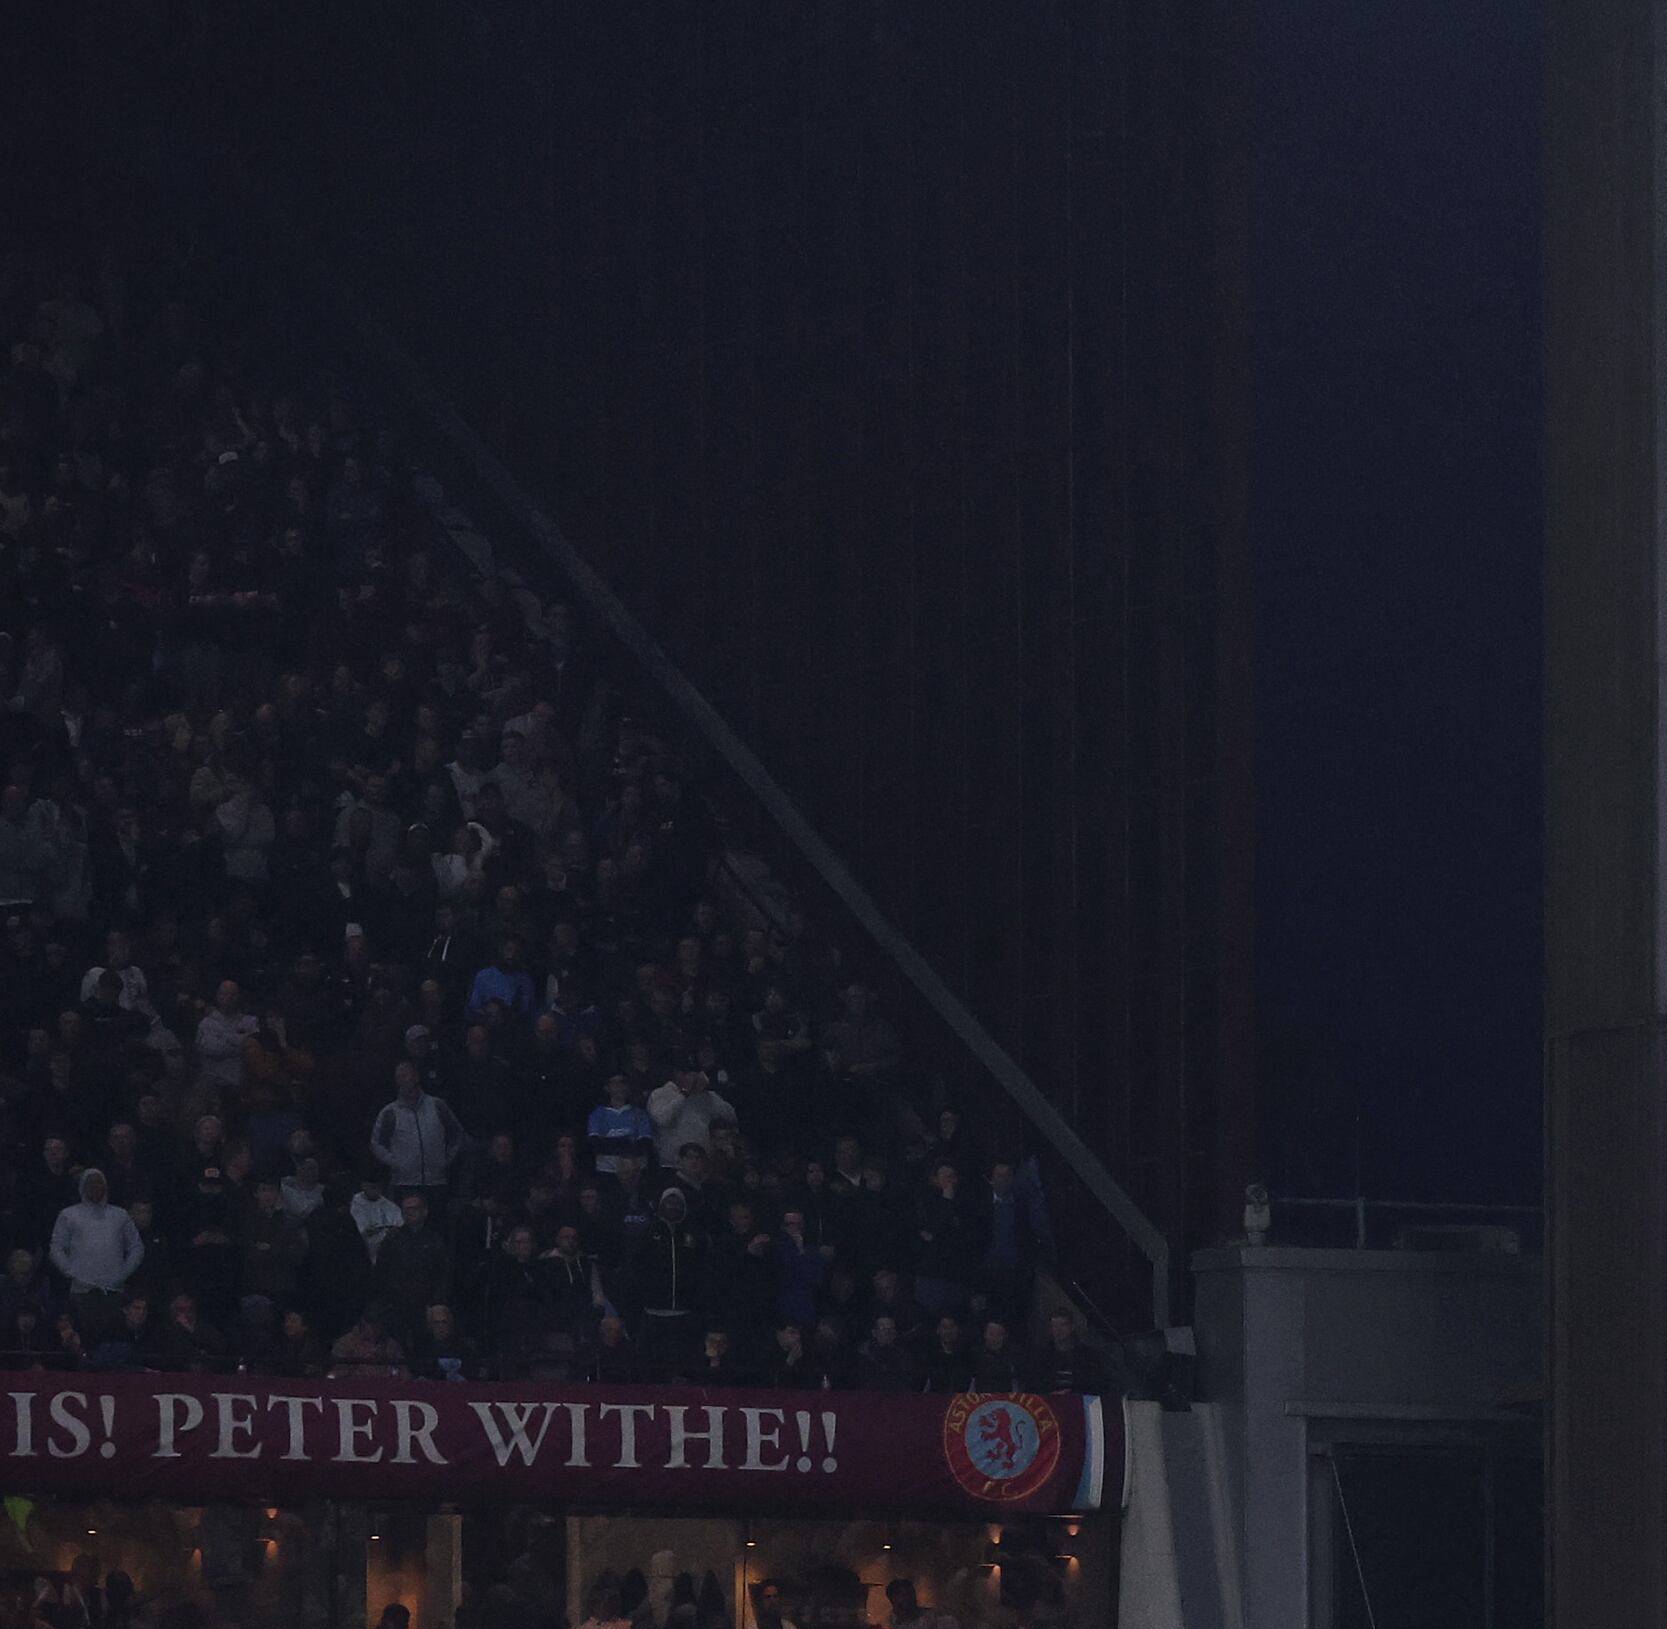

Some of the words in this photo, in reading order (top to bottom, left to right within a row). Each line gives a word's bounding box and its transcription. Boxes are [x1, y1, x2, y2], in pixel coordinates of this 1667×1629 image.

[7, 1391, 117, 1460] IS!
[151, 1393, 450, 1467] PETER
[467, 1402, 840, 1475] WITHE!!
